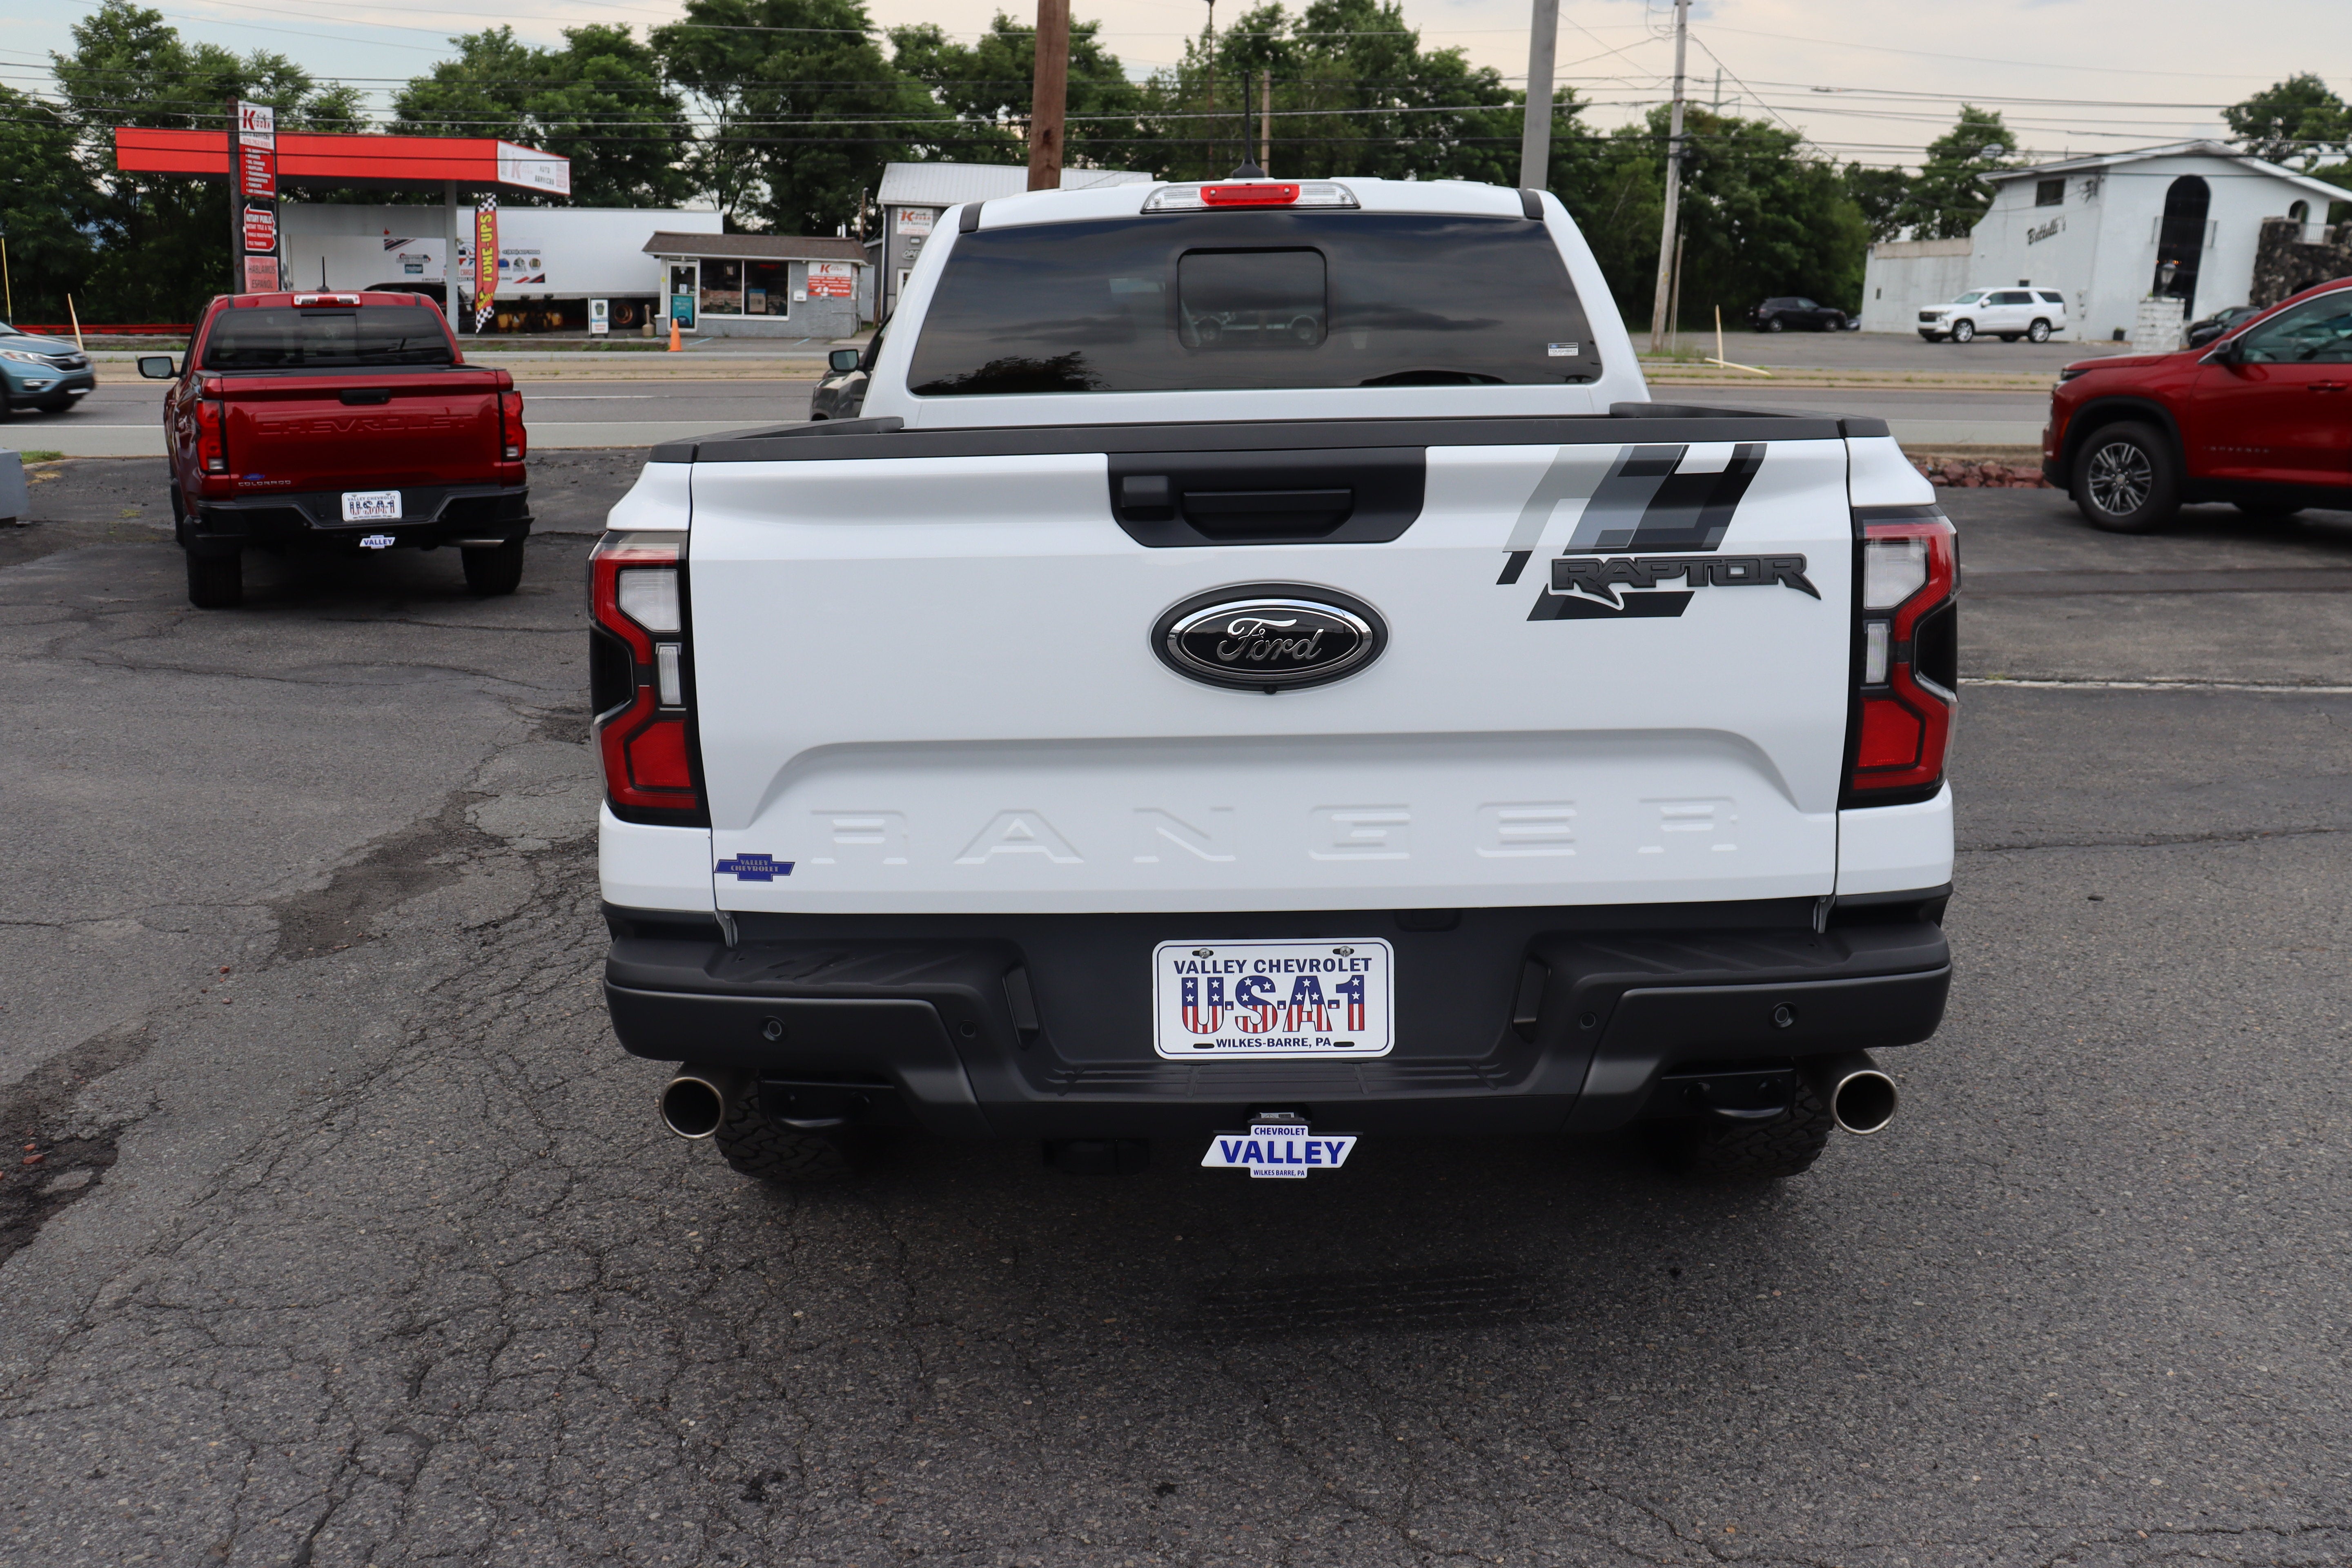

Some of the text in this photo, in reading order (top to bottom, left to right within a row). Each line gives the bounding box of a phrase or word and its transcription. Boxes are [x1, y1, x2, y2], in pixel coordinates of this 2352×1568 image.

[540, 165, 550, 174] AUTO
[246, 214, 272, 224] NOTARY PUBLIC
[248, 265, 276, 274] HABLAMOS
[252, 278, 273, 288] ESPAÑOL
[258, 416, 473, 435] CHEVROLET
[1552, 553, 1822, 606] RAPTOR
[1217, 617, 1325, 661] Ford
[812, 798, 1739, 866] RANGER
[1173, 957, 1372, 975] VALLEY CHEVROLET
[1216, 1037, 1332, 1049] WILKES-BARRE, PA
[1254, 1127, 1306, 1136] CHEVROLET
[1220, 1140, 1346, 1164] VALLEY
